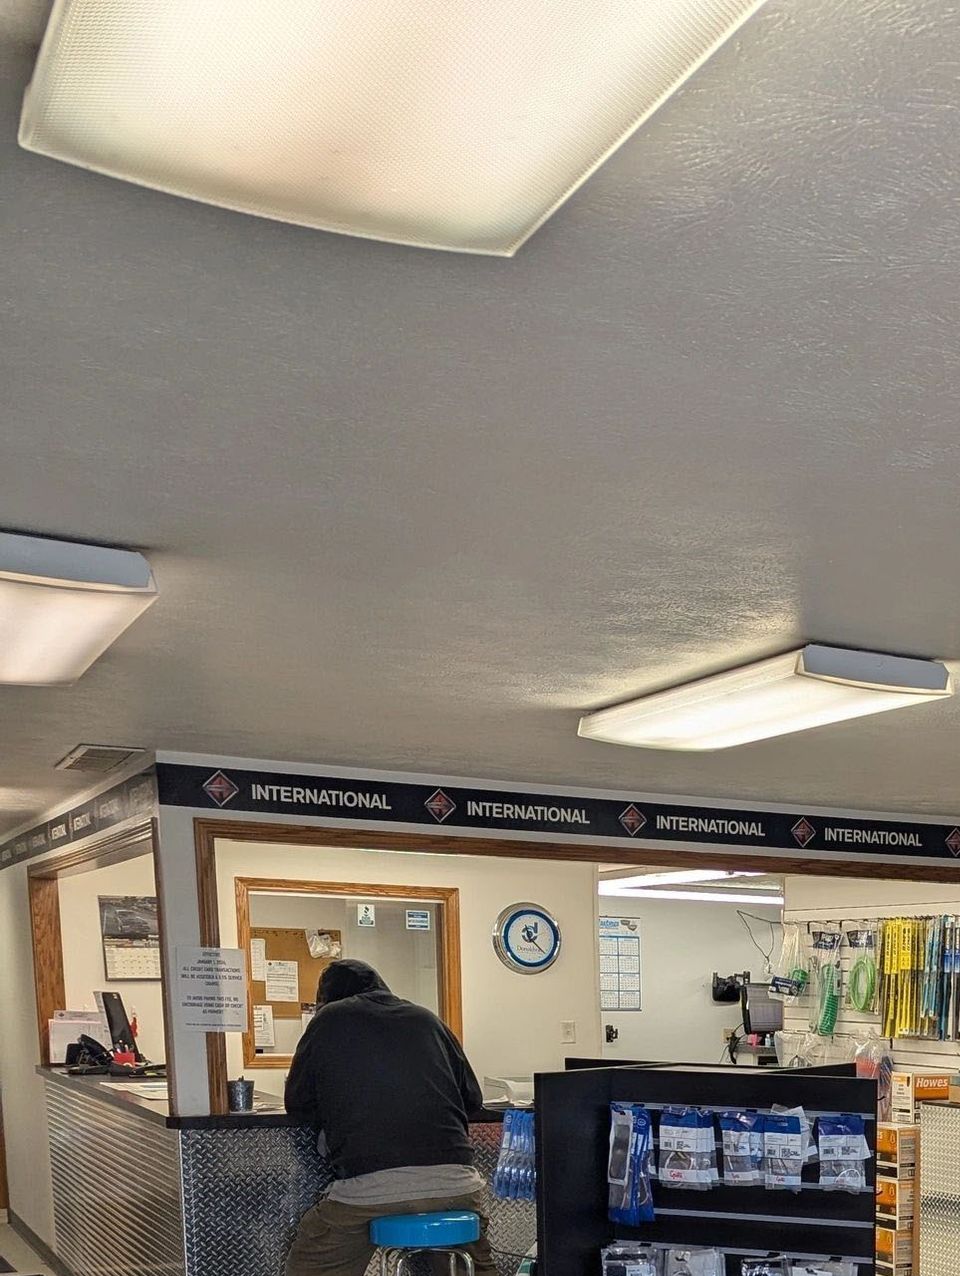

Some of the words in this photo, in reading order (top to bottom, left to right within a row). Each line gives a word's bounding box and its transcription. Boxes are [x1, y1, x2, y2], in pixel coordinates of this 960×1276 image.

[251, 783, 391, 810] INTERNATIONAL
[466, 800, 590, 825] INTERNATIONAL
[656, 815, 765, 837] INTERNATIONAL
[824, 827, 923, 848] INTERNATIONAL
[916, 1077, 949, 1089] Howes
